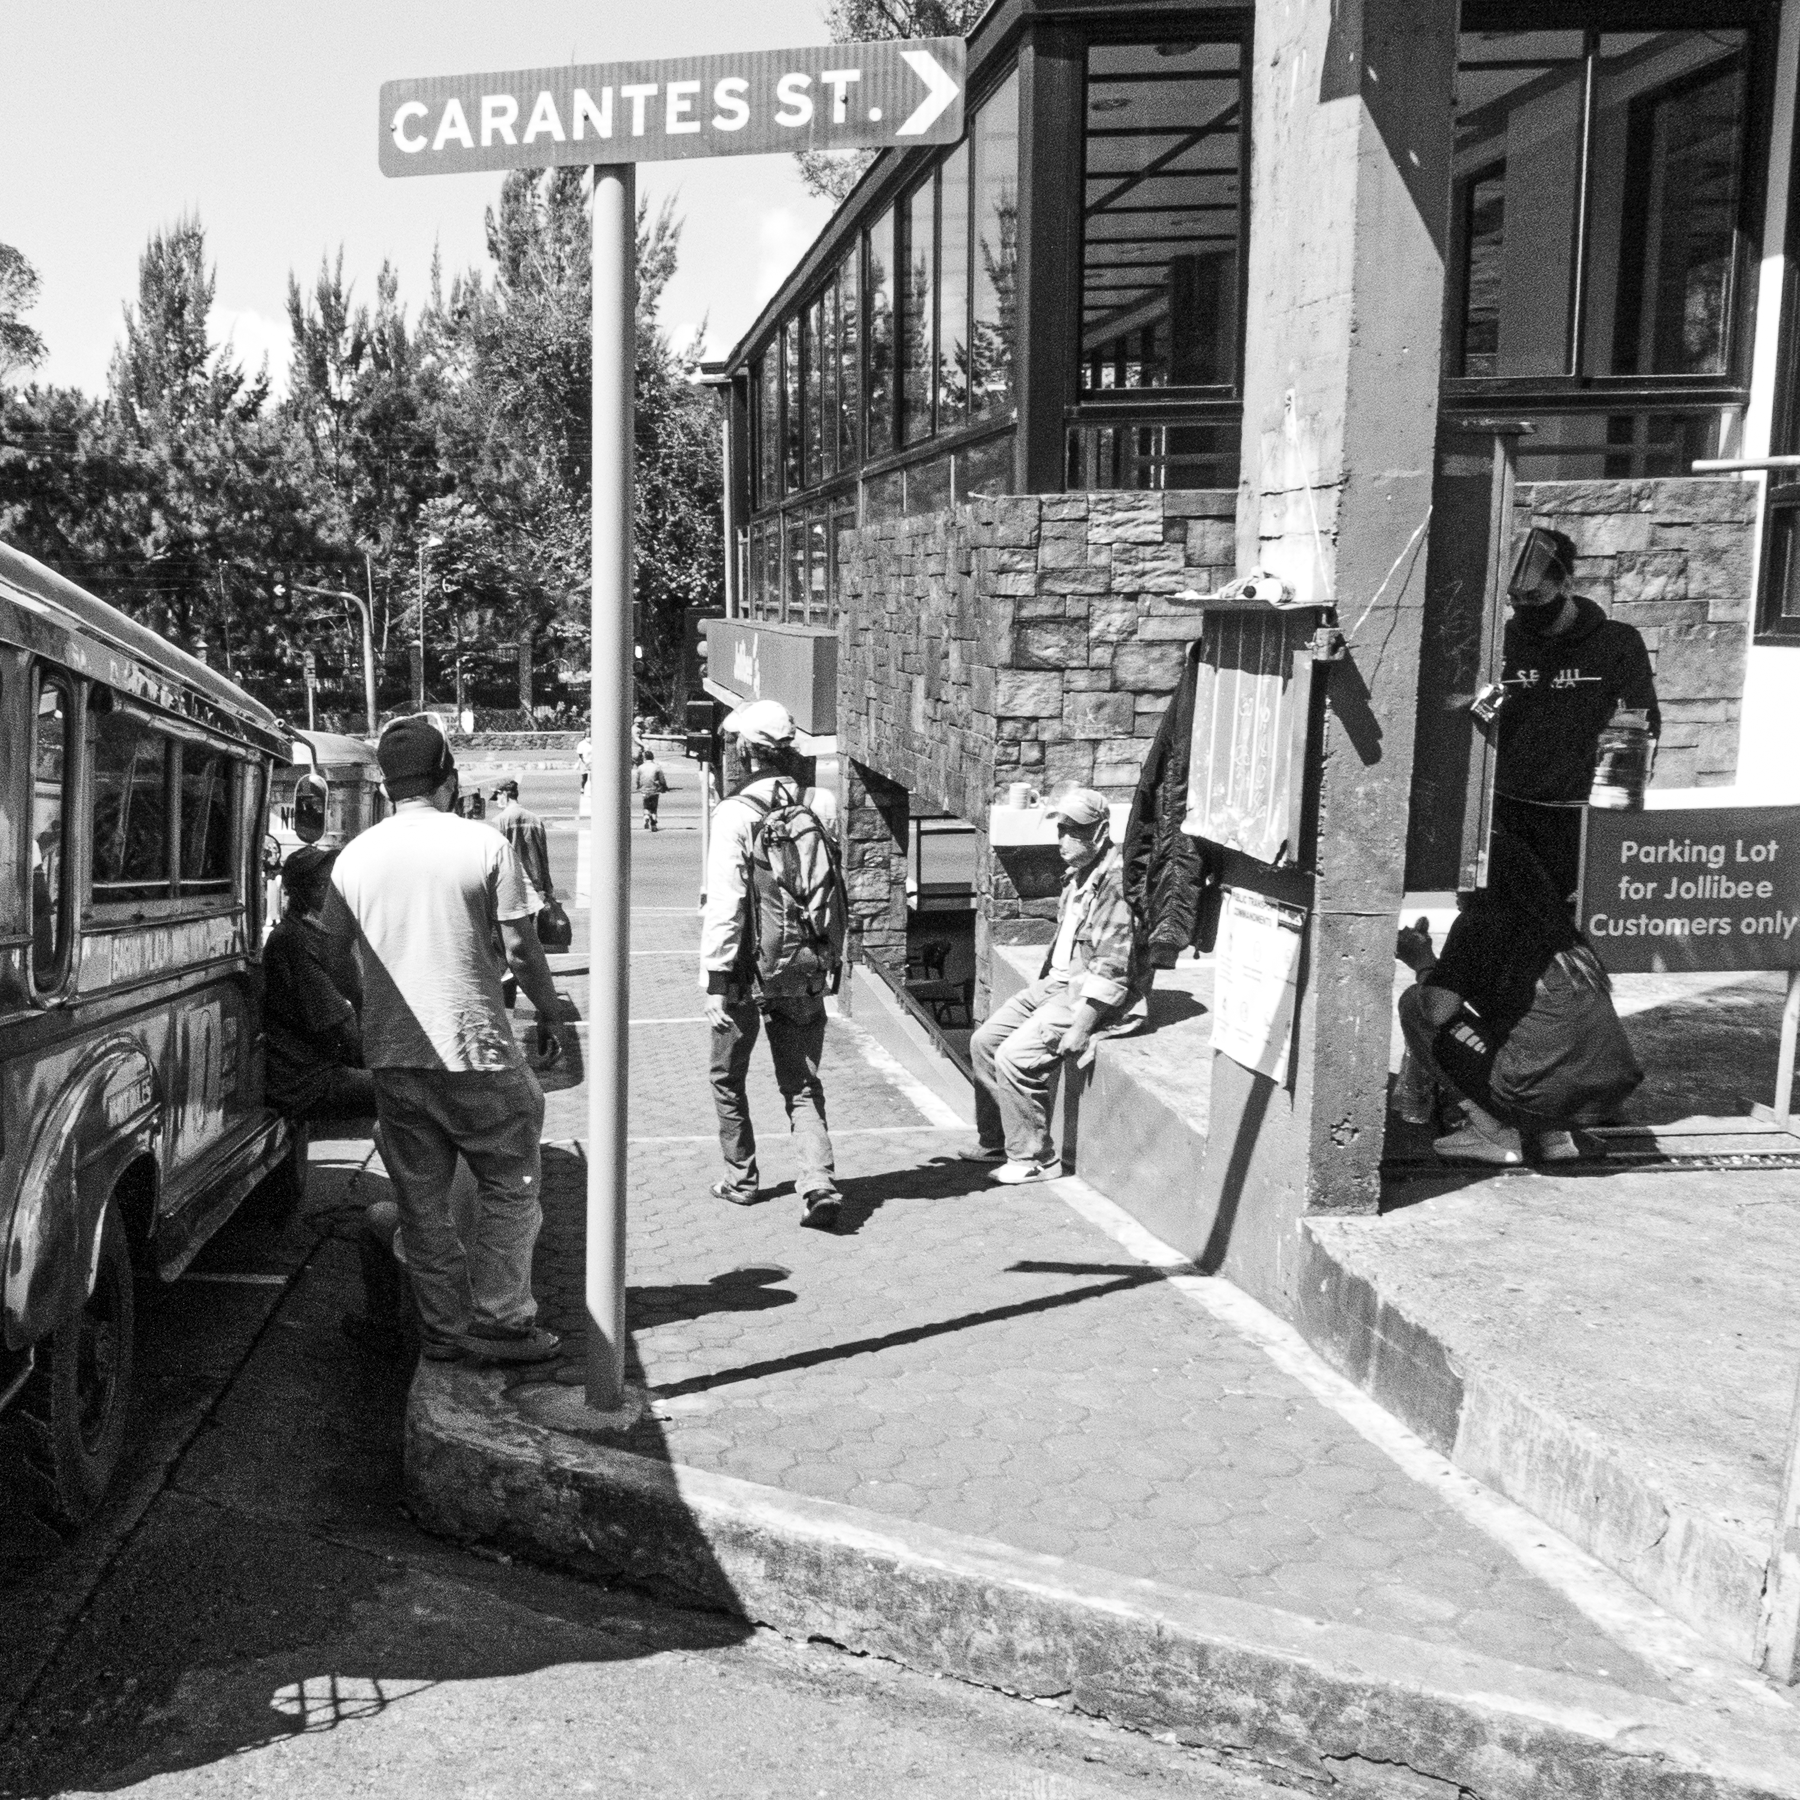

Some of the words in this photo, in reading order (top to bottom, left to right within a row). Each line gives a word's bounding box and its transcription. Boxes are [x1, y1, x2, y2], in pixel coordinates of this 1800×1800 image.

[391, 76, 750, 153] CARANTES
[774, 69, 884, 128] ST.
[1620, 838, 1725, 869] Parking
[1735, 839, 1779, 862] Lot
[1617, 875, 1657, 900] for
[1664, 874, 1773, 899] Jollibee
[1589, 913, 1732, 936] Customers
[1740, 910, 1798, 940] only
